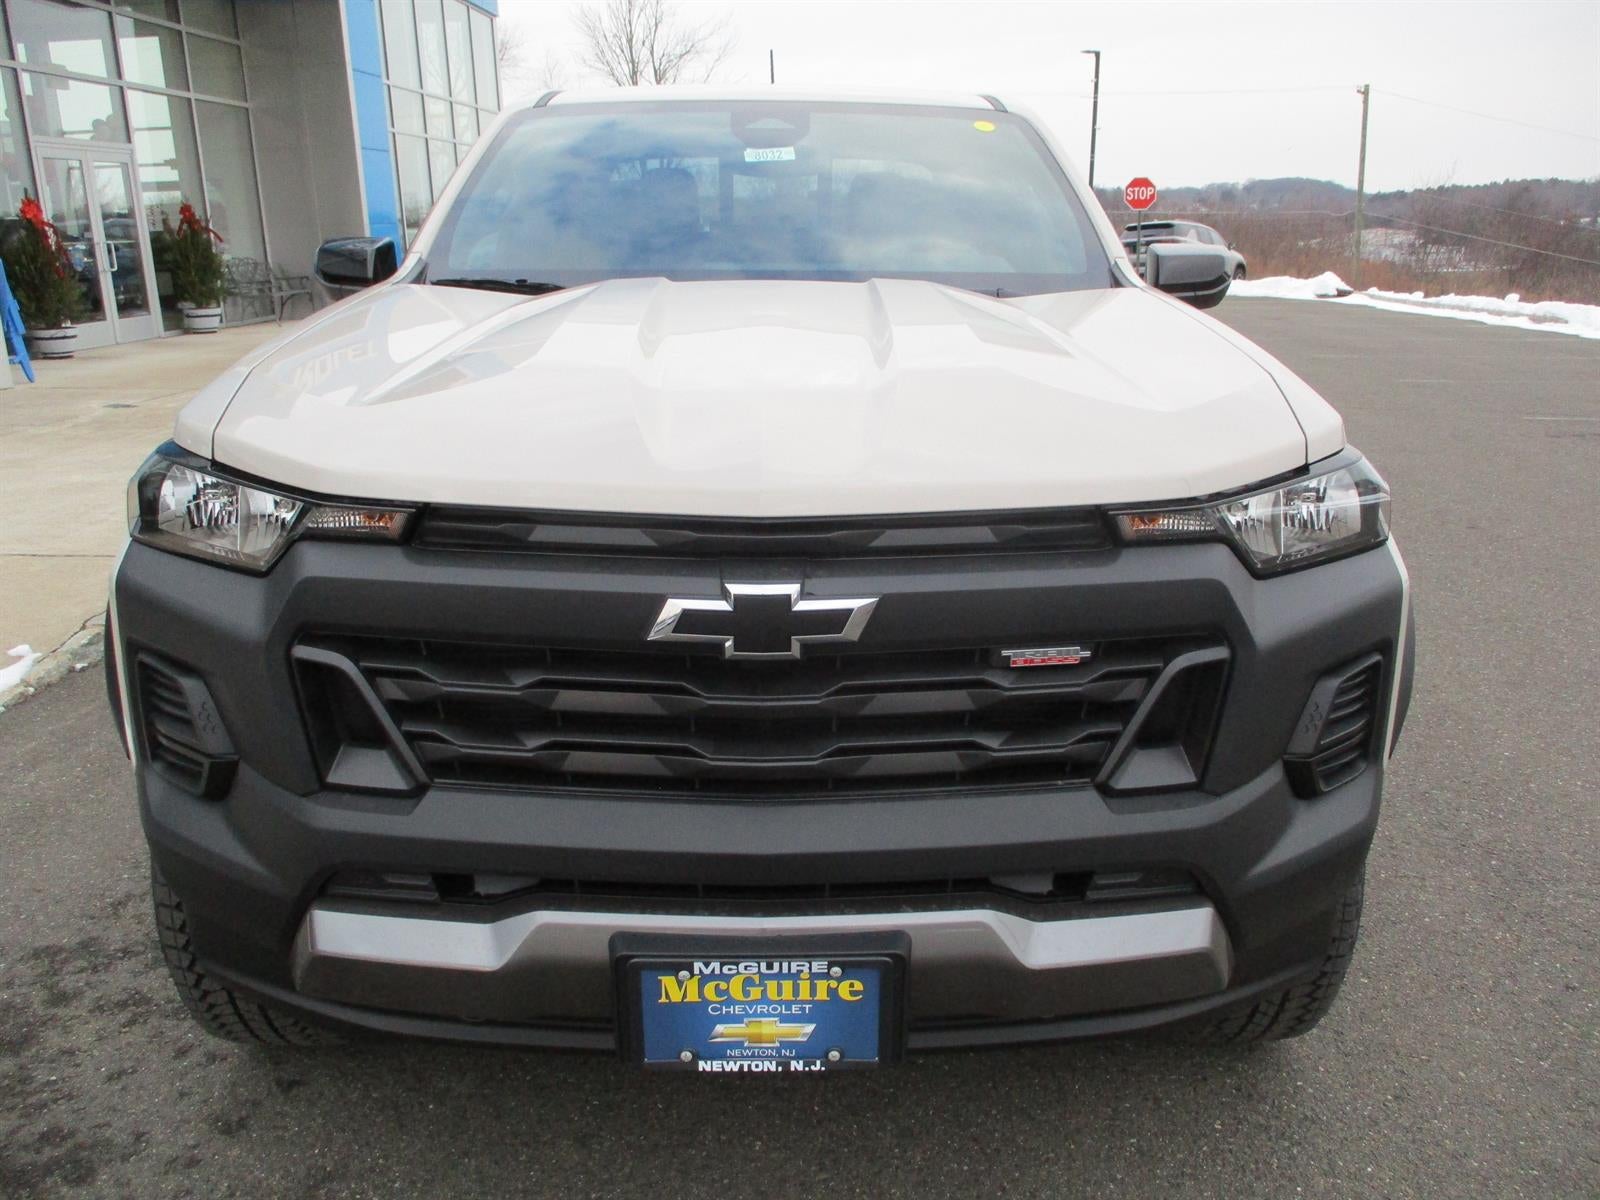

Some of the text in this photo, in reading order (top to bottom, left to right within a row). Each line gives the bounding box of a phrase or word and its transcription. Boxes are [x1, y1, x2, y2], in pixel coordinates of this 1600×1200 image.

[1126, 187, 1155, 200] STOP
[693, 962, 829, 974] McGUIRE
[658, 974, 864, 1003] McGuire
[708, 1003, 812, 1014] CHEVROLET
[727, 1049, 795, 1057] NEWTON, NJ
[698, 1060, 825, 1071] NEWTON, N.J.
